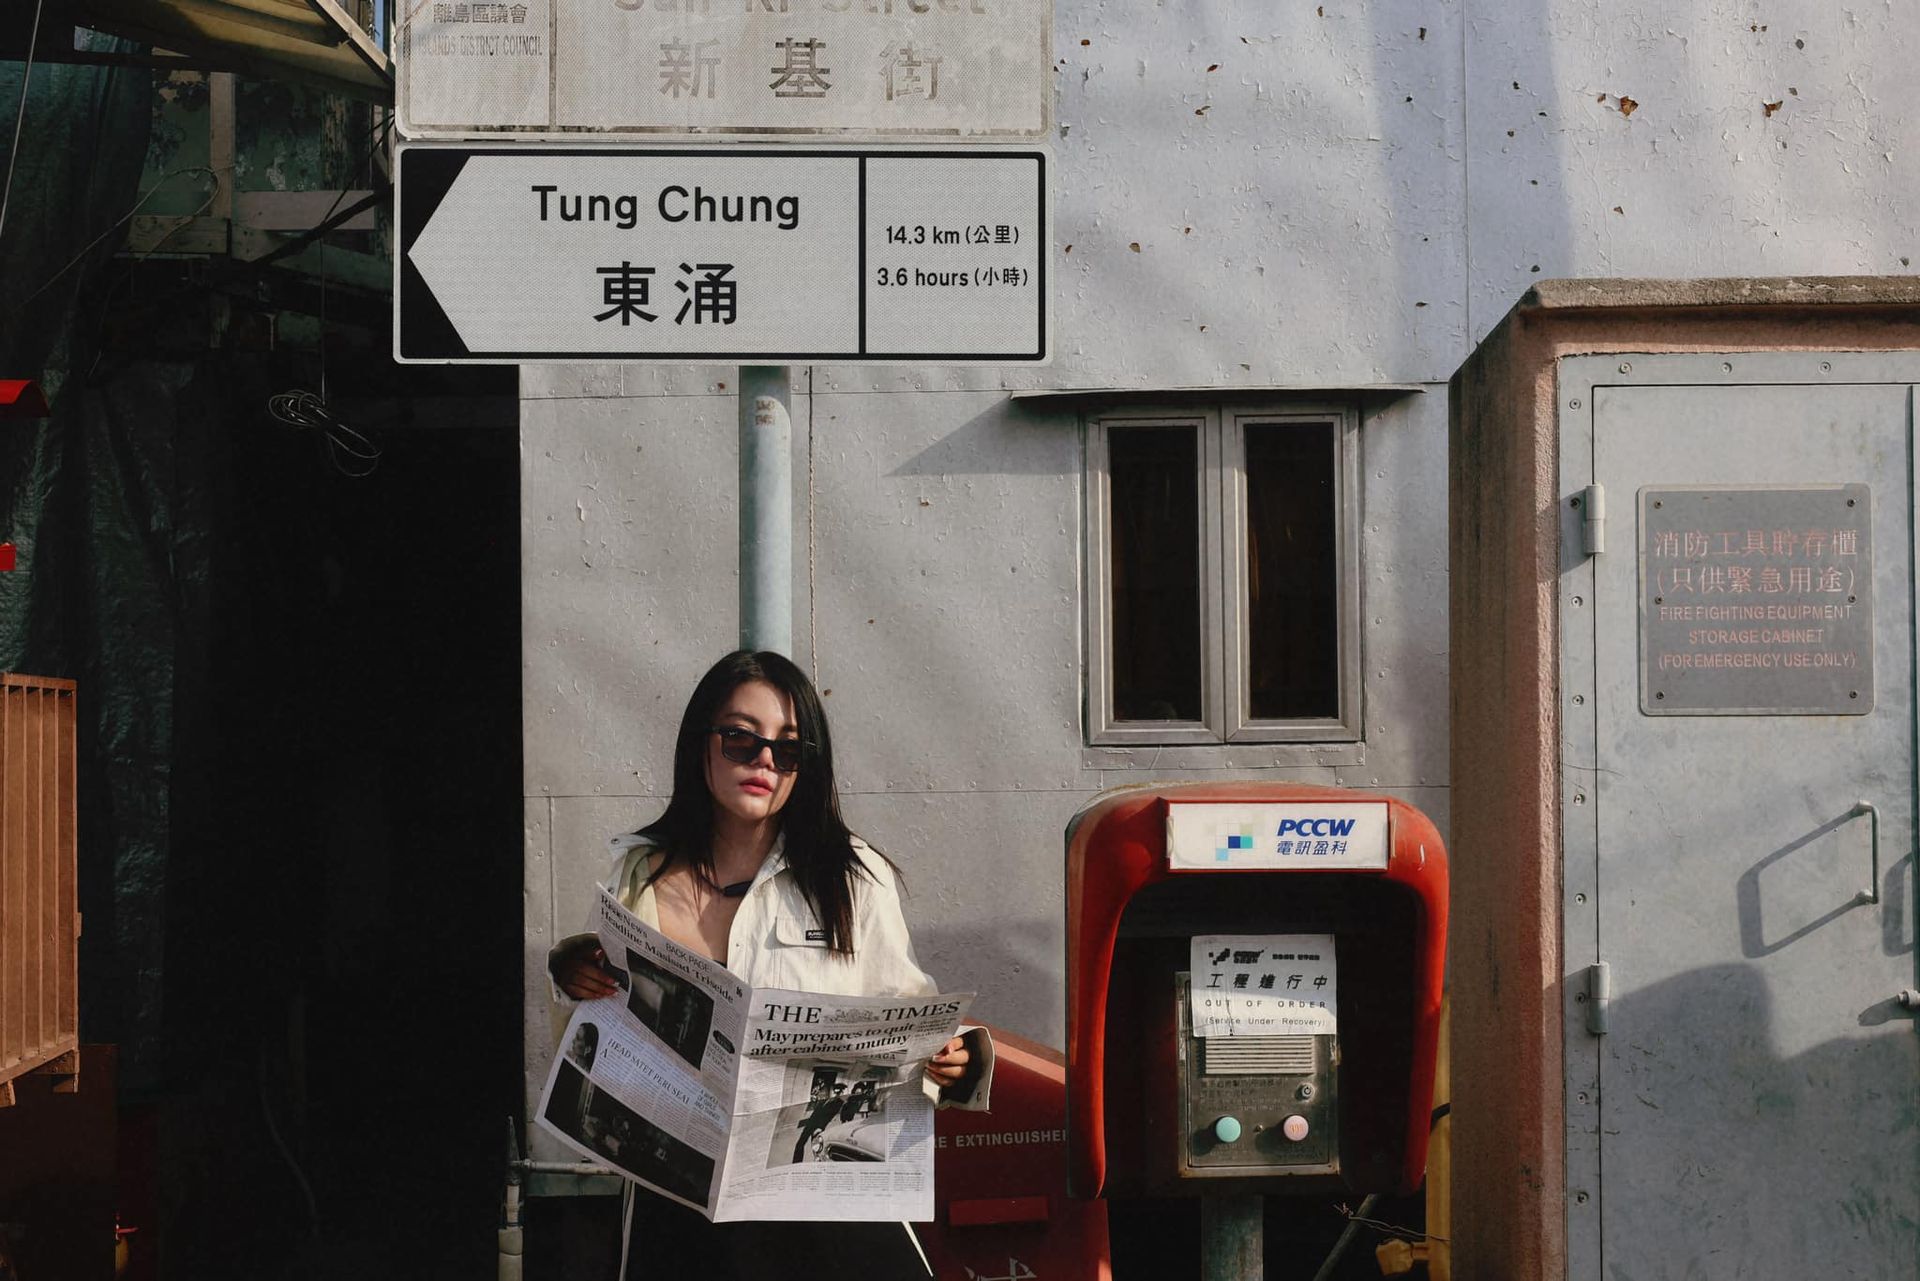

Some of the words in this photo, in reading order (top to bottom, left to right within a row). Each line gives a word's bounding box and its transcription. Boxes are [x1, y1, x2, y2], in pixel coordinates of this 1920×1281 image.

[433, 3, 528, 24] 離島區議會
[460, 35, 500, 56] DISTRICT
[503, 35, 543, 56] COUNCIL
[659, 37, 944, 101] 新基街
[531, 185, 638, 230] Tung
[658, 185, 799, 231] Chung
[886, 225, 926, 244] 14.3
[933, 225, 960, 244] km
[965, 224, 1019, 245] (公里)
[877, 267, 908, 286] 3.6
[915, 267, 969, 287] hours
[974, 266, 1028, 287] (小時)
[592, 261, 737, 326] 東涌
[1655, 529, 1858, 558] 消防工具貯存櫃
[1656, 566, 1855, 595] (只供緊急用途)
[1660, 606, 1693, 621] FIRE
[1696, 606, 1764, 621] FIGHTING
[1767, 605, 1852, 620] EQUIPMENT
[1689, 629, 1759, 645] STORAGE
[1761, 628, 1825, 644] CABINET
[1658, 653, 1692, 670] (FOR
[1694, 652, 1781, 668] EMERGENCY
[1783, 652, 1811, 668] USE
[1813, 651, 1857, 669] ONLY)
[1277, 819, 1356, 837] PCCW
[1276, 840, 1348, 856] 電訊盈科
[601, 907, 642, 946] Headline
[1206, 973, 1328, 990] 工程進行中
[764, 1003, 822, 1024] THE
[882, 1001, 960, 1021] TIMES
[1205, 999, 1231, 1008] OUT
[1246, 999, 1263, 1008] OF
[1277, 999, 1327, 1009] ORDER
[1248, 1016, 1275, 1025] Under
[1281, 1017, 1325, 1026] Recovery)
[754, 1028, 789, 1044] May
[790, 1030, 863, 1044] prepares
[865, 1026, 882, 1037] to
[883, 1022, 916, 1037] quit
[607, 1037, 632, 1059] HEAD
[750, 1043, 792, 1056] after
[793, 1042, 851, 1055] cabinet
[855, 1033, 911, 1050] mutiny
